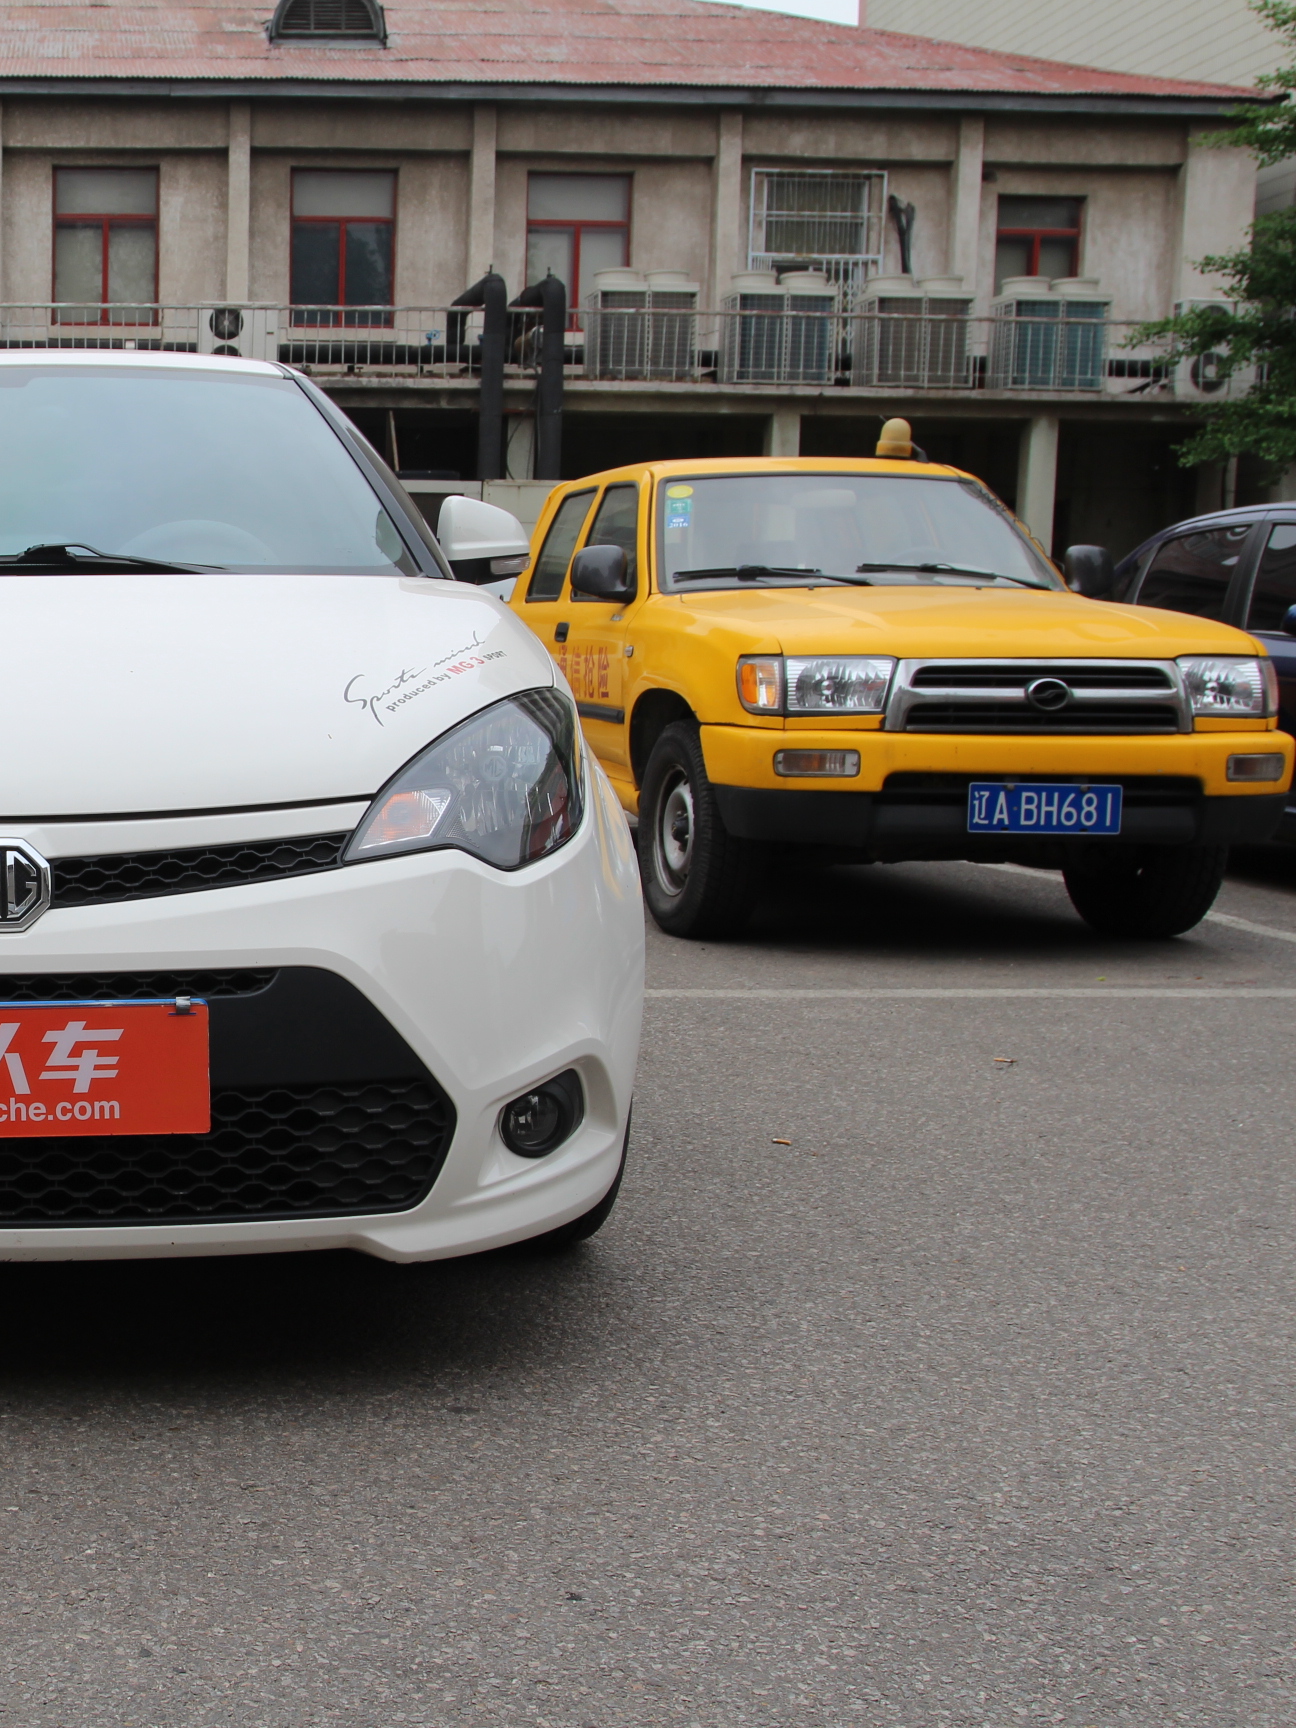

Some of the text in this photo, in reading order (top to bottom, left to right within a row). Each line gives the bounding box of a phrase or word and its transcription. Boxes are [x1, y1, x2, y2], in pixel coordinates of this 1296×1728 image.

[433, 630, 486, 667] mind
[385, 650, 508, 712] produced by MG 3 SPORT
[485, 759, 504, 777] MG
